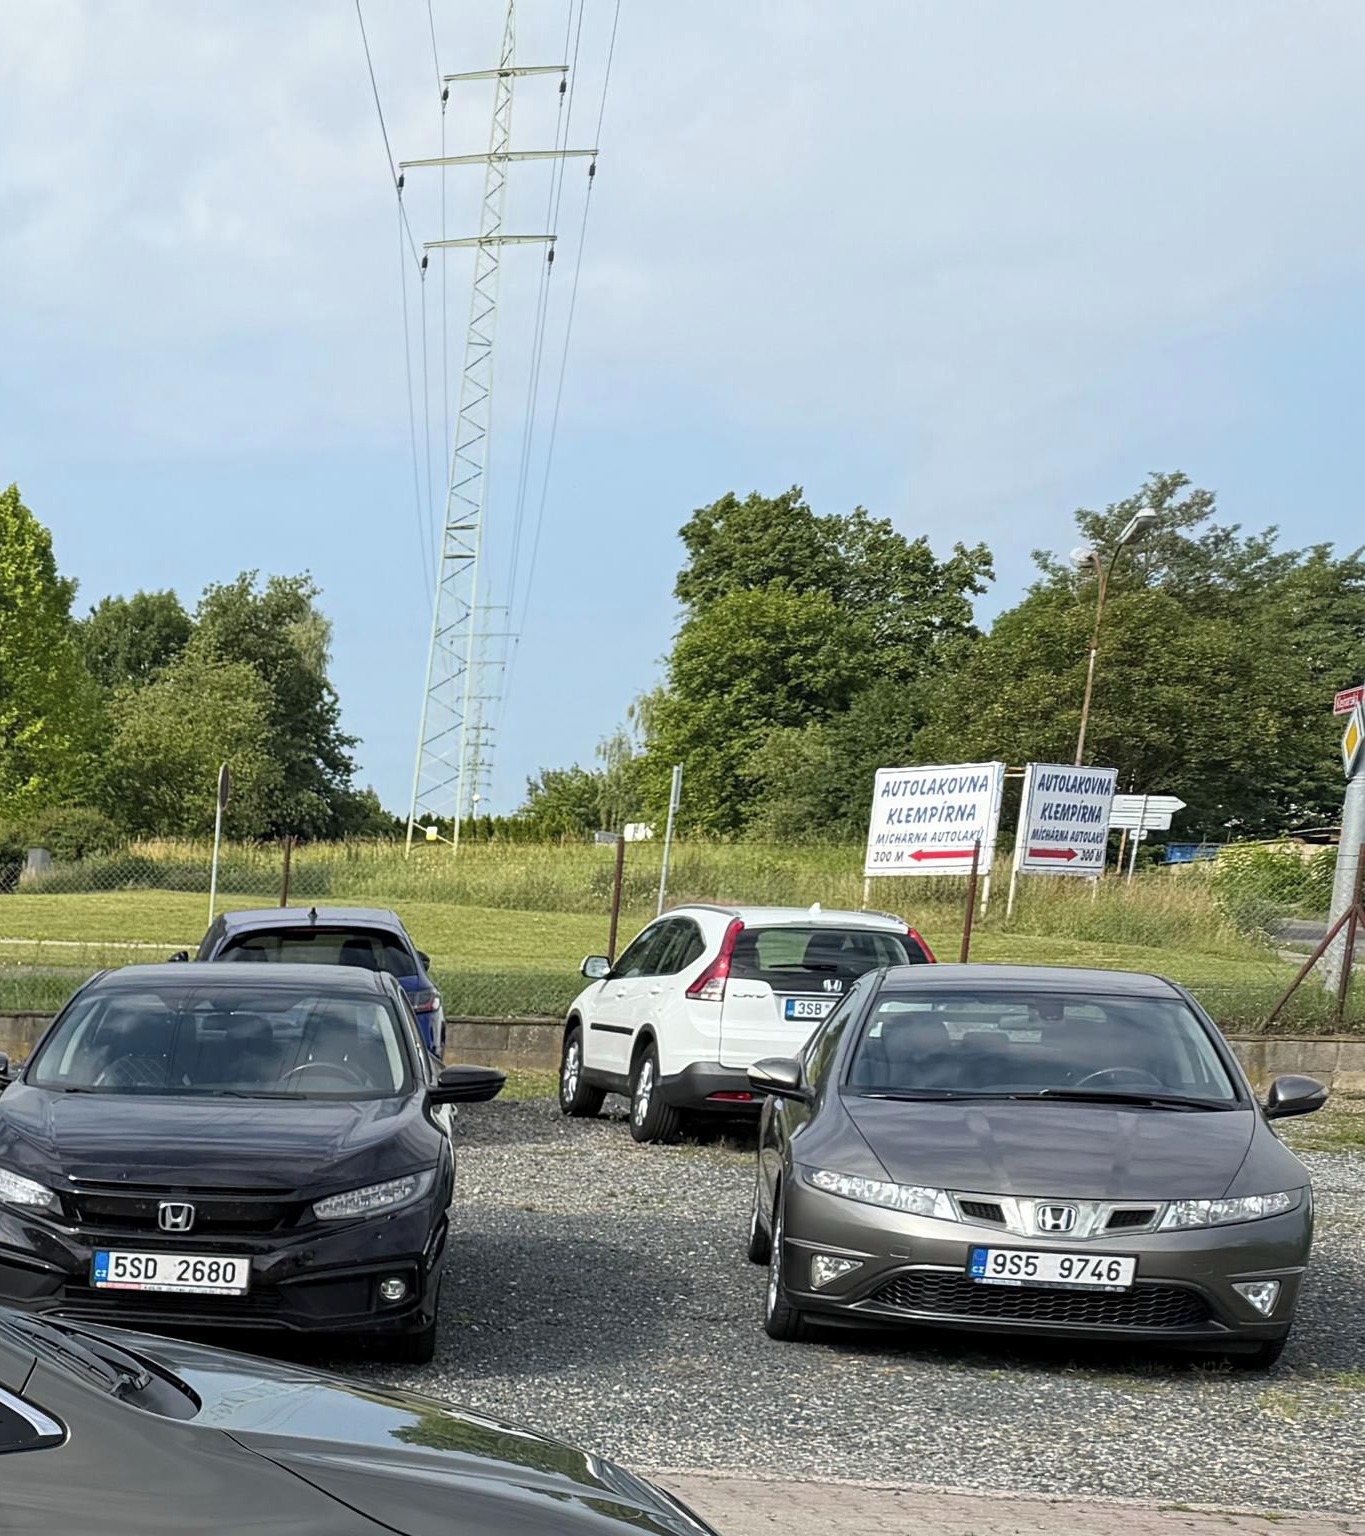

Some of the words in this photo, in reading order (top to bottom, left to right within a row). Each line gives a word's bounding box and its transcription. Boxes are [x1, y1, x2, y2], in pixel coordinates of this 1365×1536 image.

[881, 775, 988, 797] AUTOLAKOVNA
[1038, 774, 1111, 796] AUTOLAKOVNA
[887, 801, 976, 825] KLEMPÍRNA
[1040, 800, 1103, 823] KLEMPÍRNA
[875, 830, 928, 845] MÍCHÁRNA
[873, 852, 891, 863] 300
[894, 851, 904, 862] M
[797, 1002, 823, 1016] 3SB
[115, 1256, 157, 1279] 5SD
[177, 1260, 235, 1283] 2680
[993, 1254, 1039, 1276] 9S5
[1059, 1258, 1121, 1281] 9746
